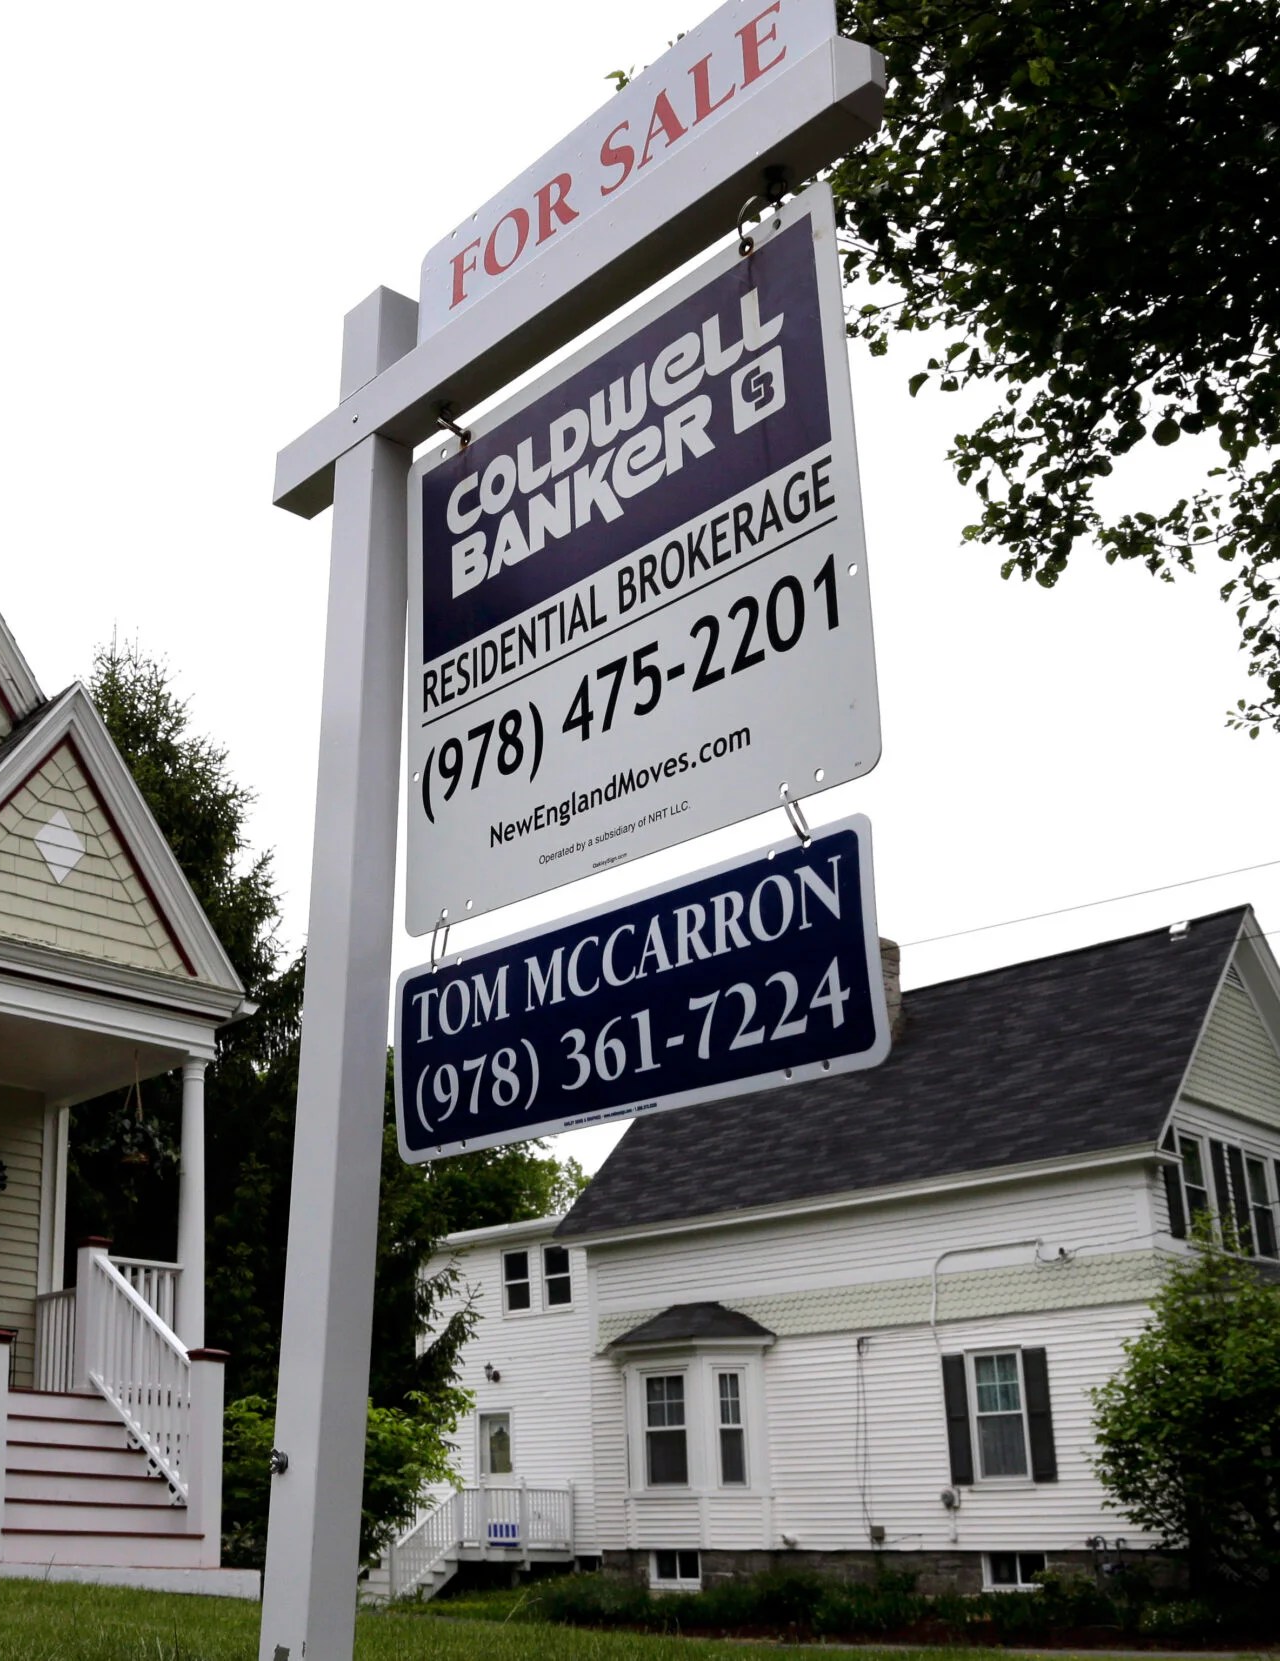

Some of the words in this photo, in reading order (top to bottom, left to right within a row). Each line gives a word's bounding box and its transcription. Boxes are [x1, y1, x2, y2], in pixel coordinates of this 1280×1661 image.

[449, 173, 580, 311] FOR
[600, 0, 788, 197] SALE
[422, 584, 608, 713] RESIDENTIAL
[618, 455, 836, 615] BROKERAGE
[421, 701, 545, 824] (978)
[562, 553, 841, 743] 475-2201
[489, 725, 752, 848] NewEnglandMoves.com
[538, 844, 575, 865] Operated
[576, 840, 587, 852] by
[588, 838, 593, 847] a
[595, 822, 636, 844] subsidiary
[638, 816, 647, 828] of
[648, 808, 668, 824] NRT
[670, 800, 691, 816] LLC.
[412, 964, 510, 1044] TOM
[525, 855, 843, 1012] MCCARRON
[416, 1038, 540, 1132] (978)
[560, 956, 851, 1091] 361-7224
